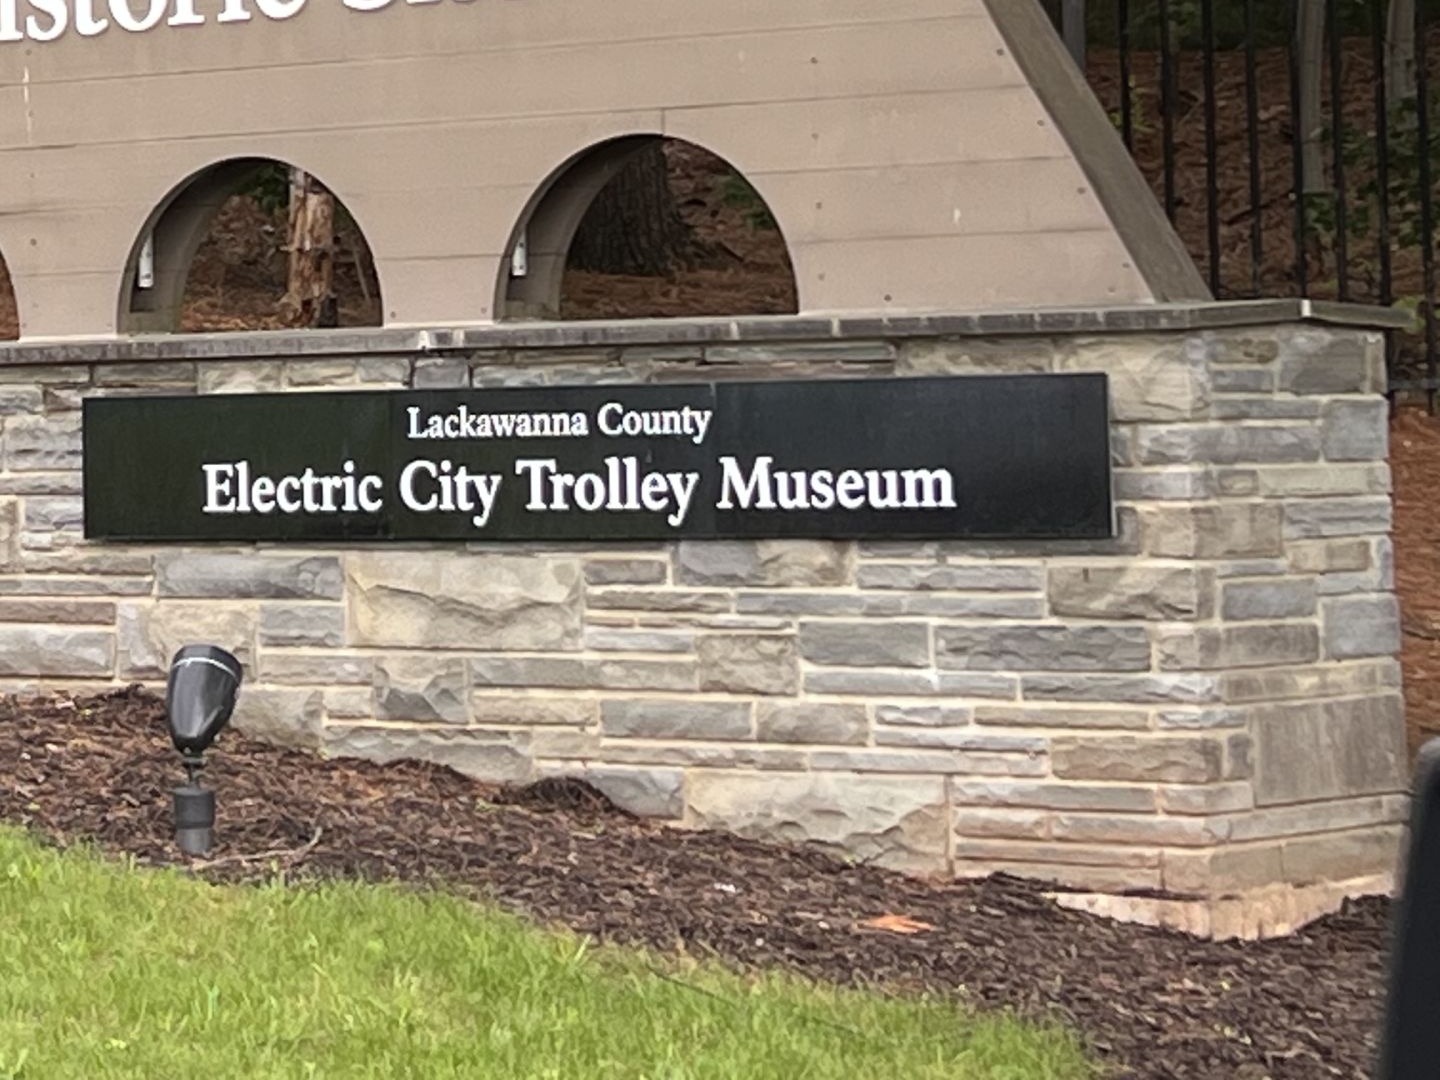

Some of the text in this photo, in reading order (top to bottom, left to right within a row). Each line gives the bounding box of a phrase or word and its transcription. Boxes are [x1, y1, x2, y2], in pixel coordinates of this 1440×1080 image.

[406, 402, 713, 444] Lackawanna County
[201, 456, 957, 527] Electric City Trolley Museum
